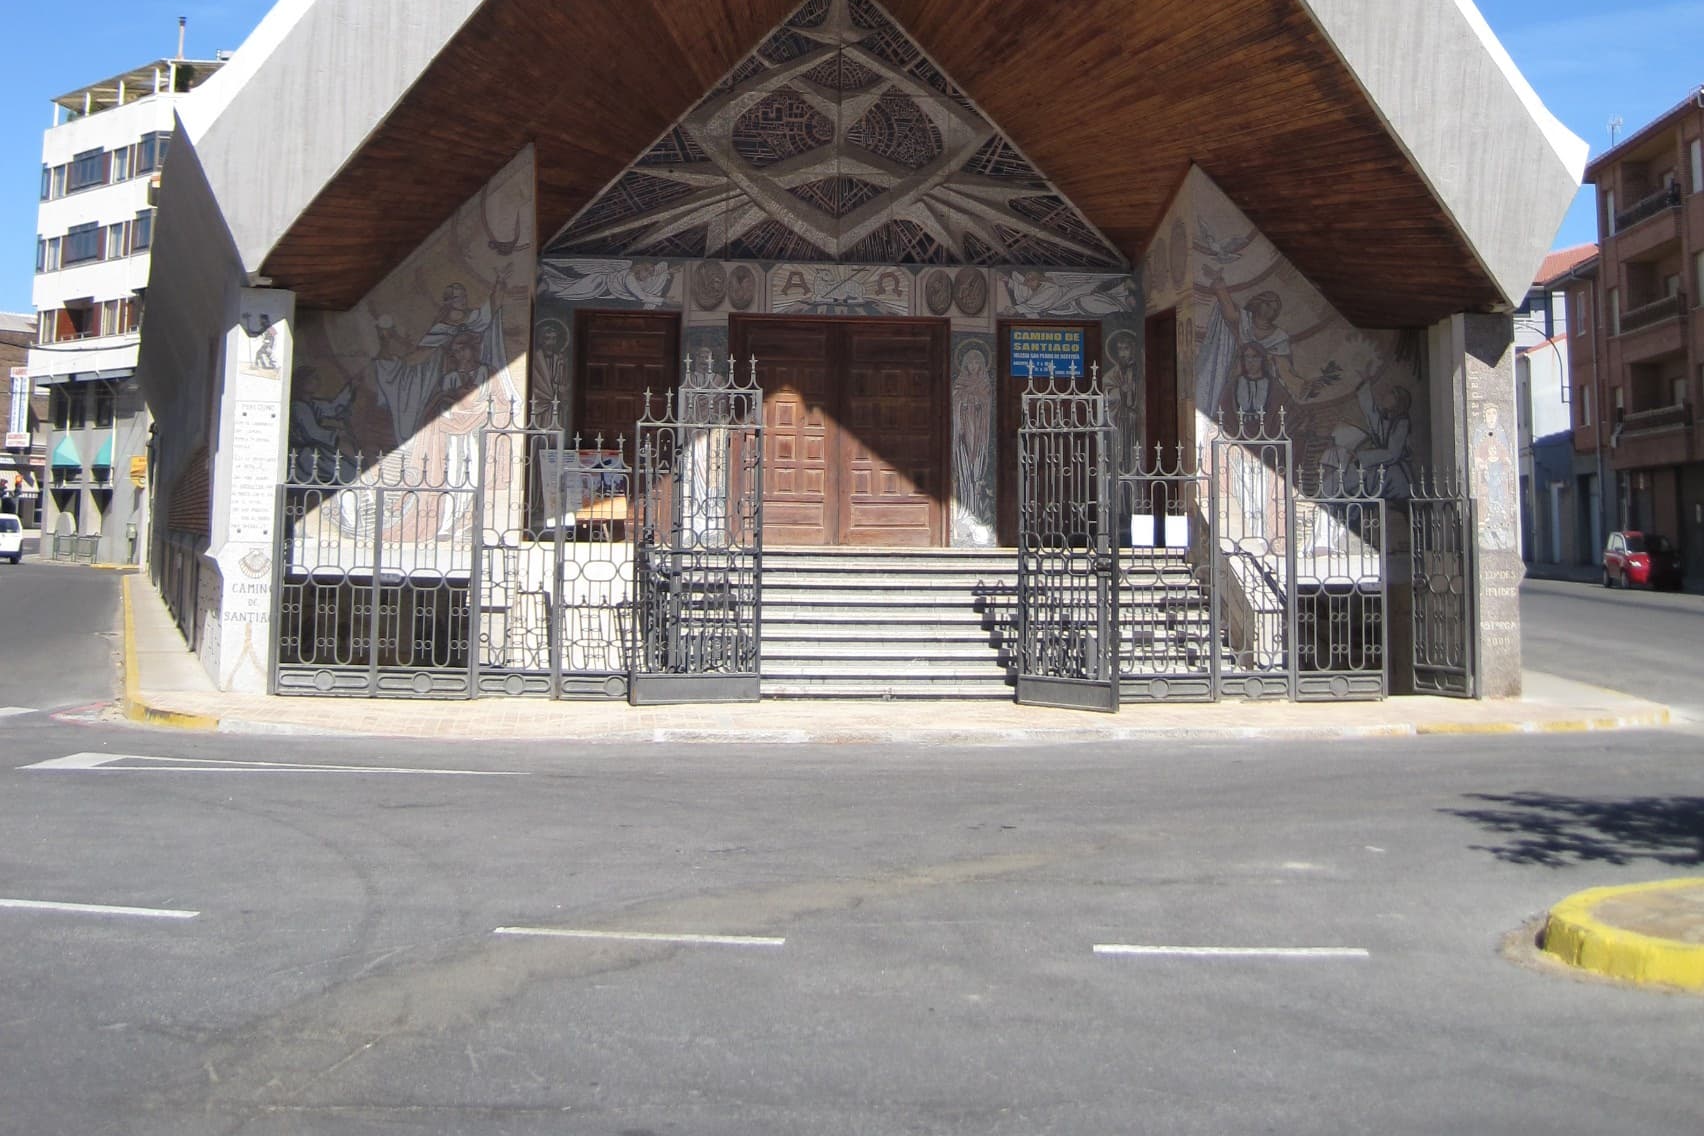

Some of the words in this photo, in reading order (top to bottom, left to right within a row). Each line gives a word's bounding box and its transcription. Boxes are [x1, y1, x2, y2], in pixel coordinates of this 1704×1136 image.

[1014, 332, 1062, 341] CAMINO
[1065, 333, 1080, 342] DE
[1014, 343, 1080, 352] SANTIAGO
[224, 611, 270, 623] SANTIA
